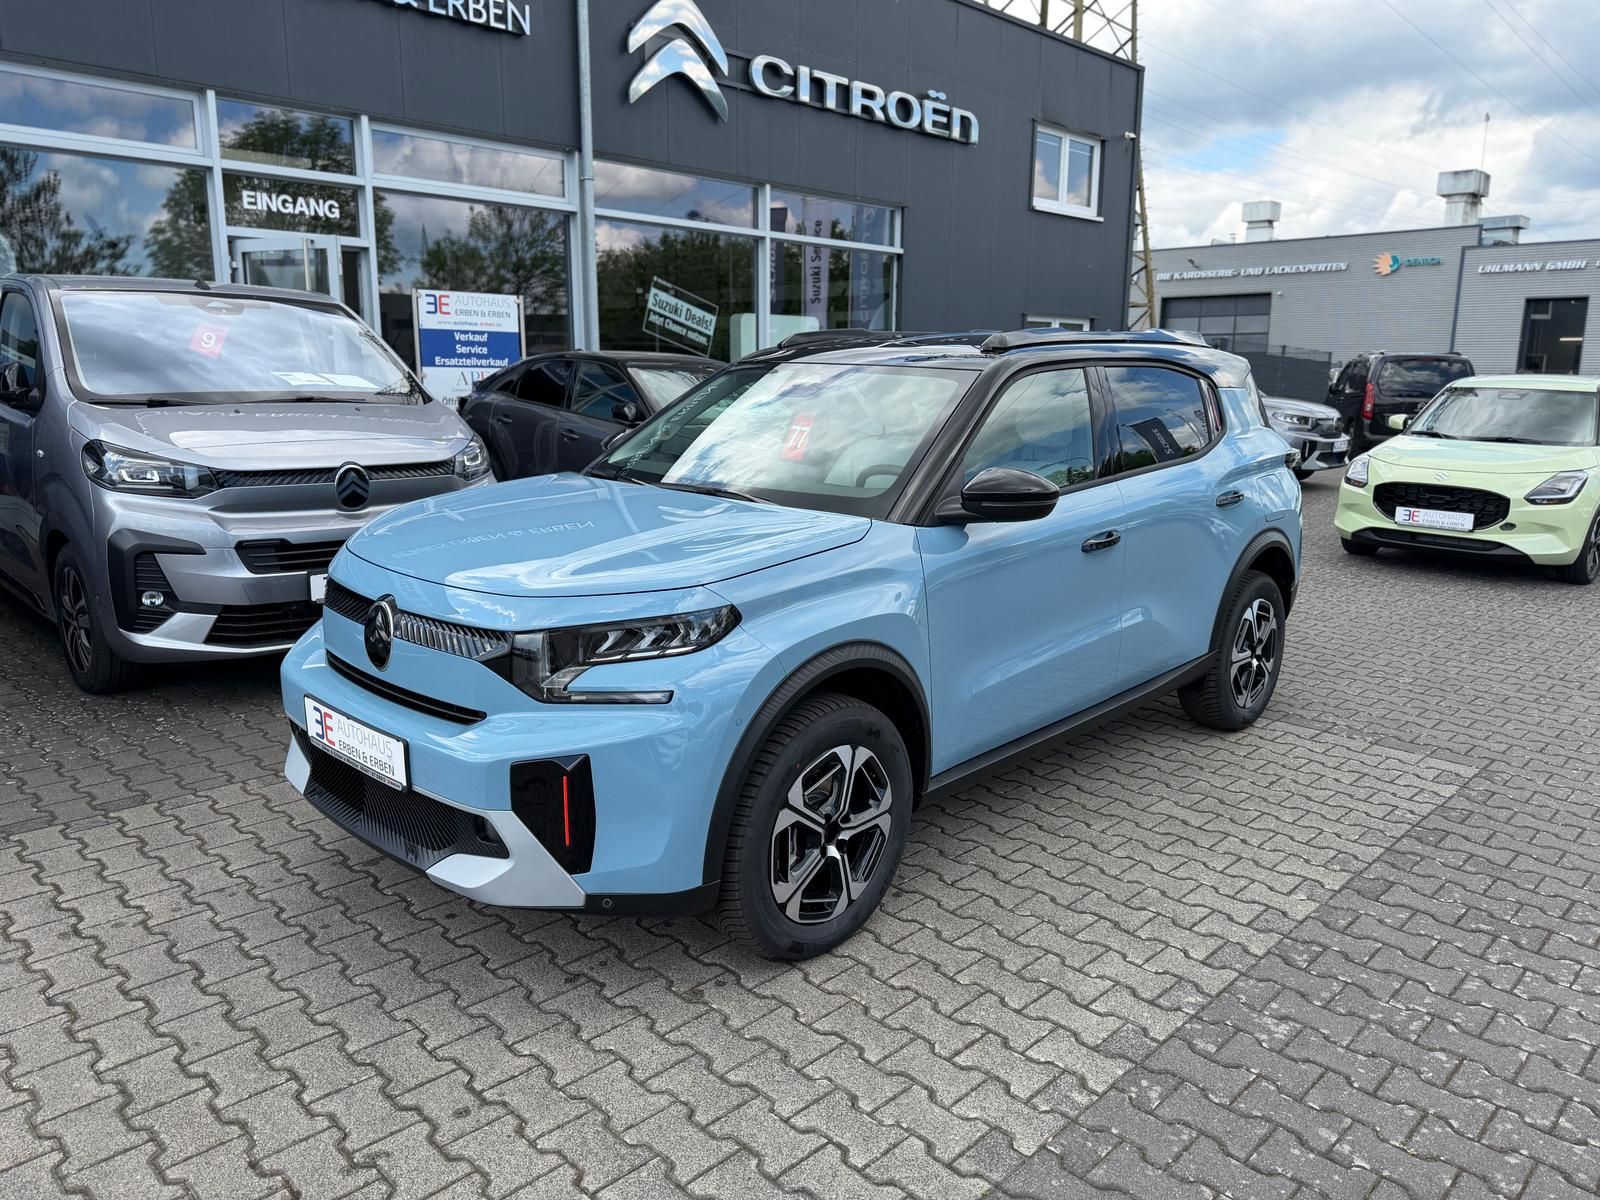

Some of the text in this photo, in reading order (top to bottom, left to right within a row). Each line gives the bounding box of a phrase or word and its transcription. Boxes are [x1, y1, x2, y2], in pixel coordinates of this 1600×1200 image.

[242, 190, 340, 218] EINGANG
[810, 220, 823, 304] Suzuki Serice
[1478, 262, 1543, 274] UHLMANN
[1545, 259, 1587, 271] GMBH
[1156, 272, 1172, 281] DIE
[1240, 266, 1262, 277] UND
[1264, 262, 1348, 275] LACKEXPERTEN
[455, 296, 511, 309] AUTOHAUS
[455, 309, 479, 317] ERBEN
[488, 311, 511, 319] ERBEN
[652, 293, 713, 331] Suzuki Deals!
[201, 332, 216, 348] 9
[454, 332, 488, 342] Verkauf
[456, 345, 488, 354] Service
[435, 356, 508, 367] Ersatzteilverkauf
[787, 425, 810, 449] 77
[1423, 511, 1466, 521] AUTOHAUS
[337, 718, 393, 759] AUTOHAUS
[338, 740, 361, 759] ERBEN
[362, 751, 368, 764] &
[369, 755, 395, 776] ERBEN
